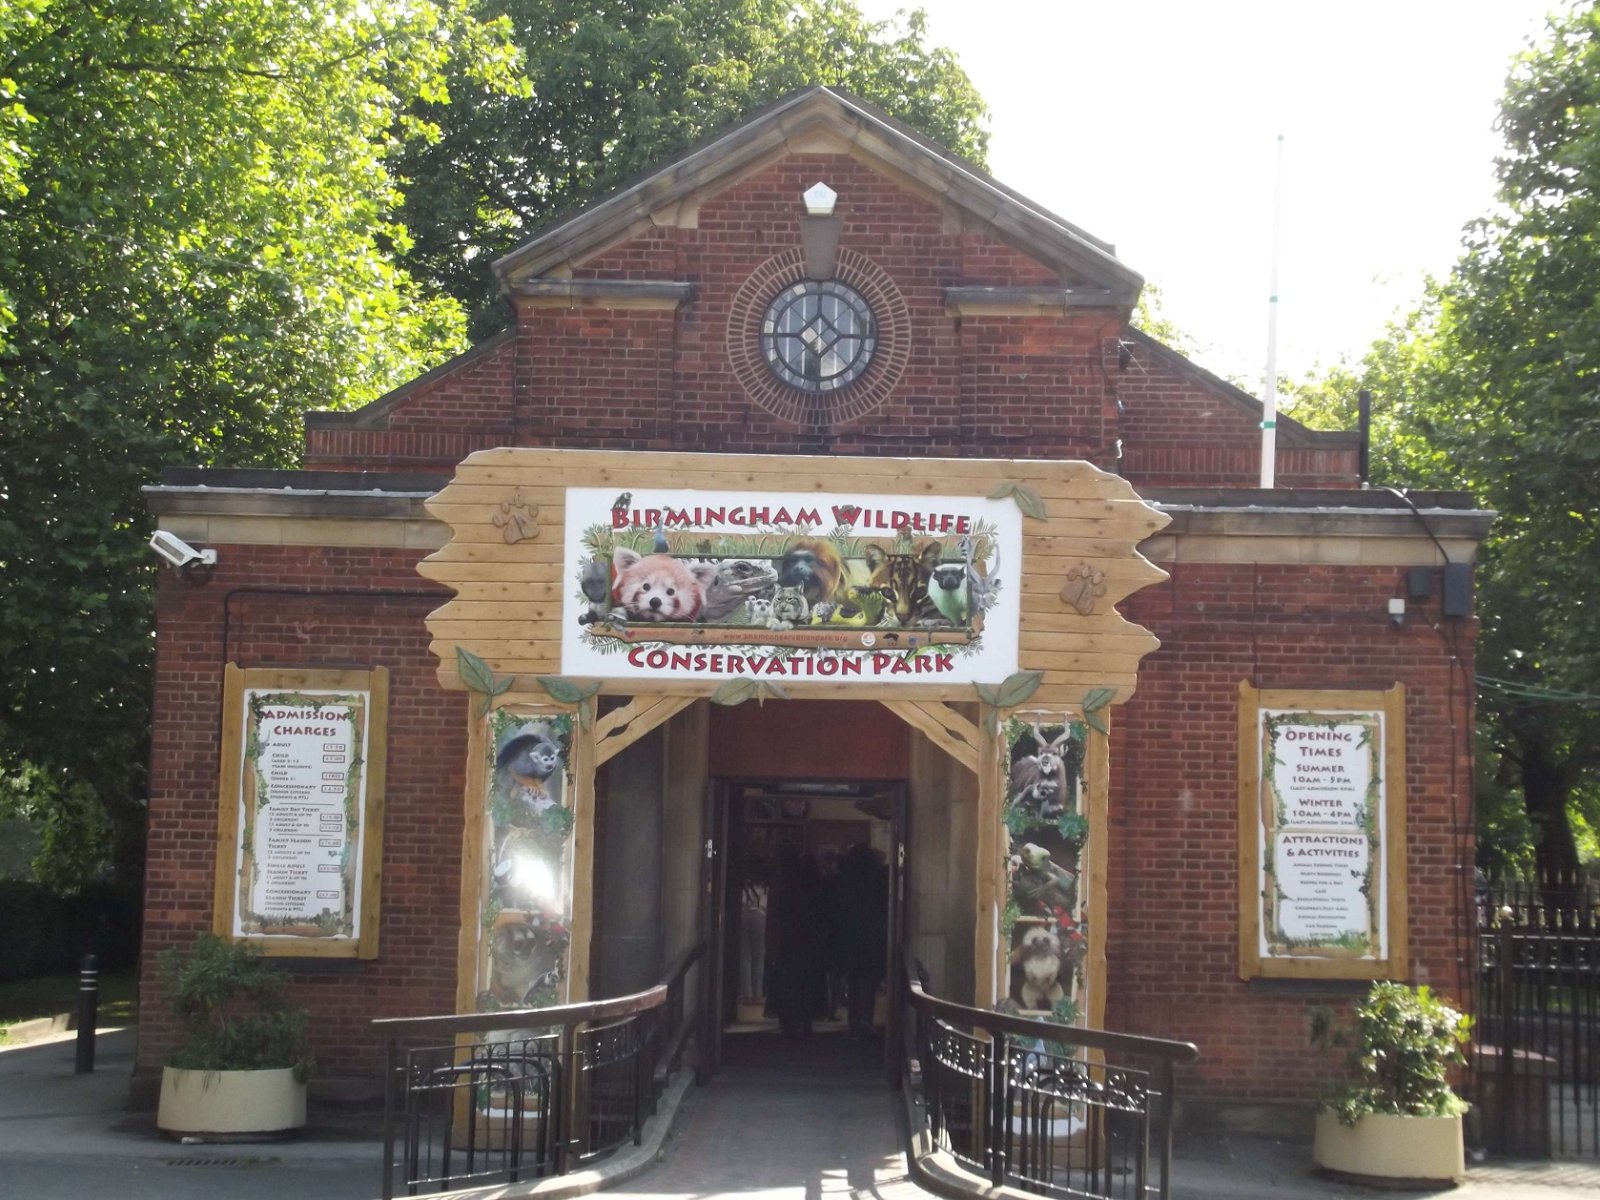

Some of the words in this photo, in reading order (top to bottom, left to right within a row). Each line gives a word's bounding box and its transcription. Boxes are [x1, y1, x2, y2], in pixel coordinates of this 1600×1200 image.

[611, 506, 822, 529] BIRMINGHAM
[831, 505, 971, 534] WILDLIFE
[627, 646, 862, 676] CONSERVATION
[873, 653, 954, 676] PARK
[264, 709, 347, 721] ADMISSION
[273, 725, 336, 737] CHARGES
[1285, 730, 1353, 742] OPENING
[1299, 746, 1342, 757] TIMES
[1296, 763, 1345, 773] SUMMER
[1292, 776, 1321, 784] 10AM
[1298, 798, 1343, 807] WINTER
[1292, 810, 1321, 818] 10AM
[1283, 836, 1364, 846] ATTRACTIONS
[1286, 848, 1295, 857] &
[1297, 848, 1361, 858] ACTIVITIES
